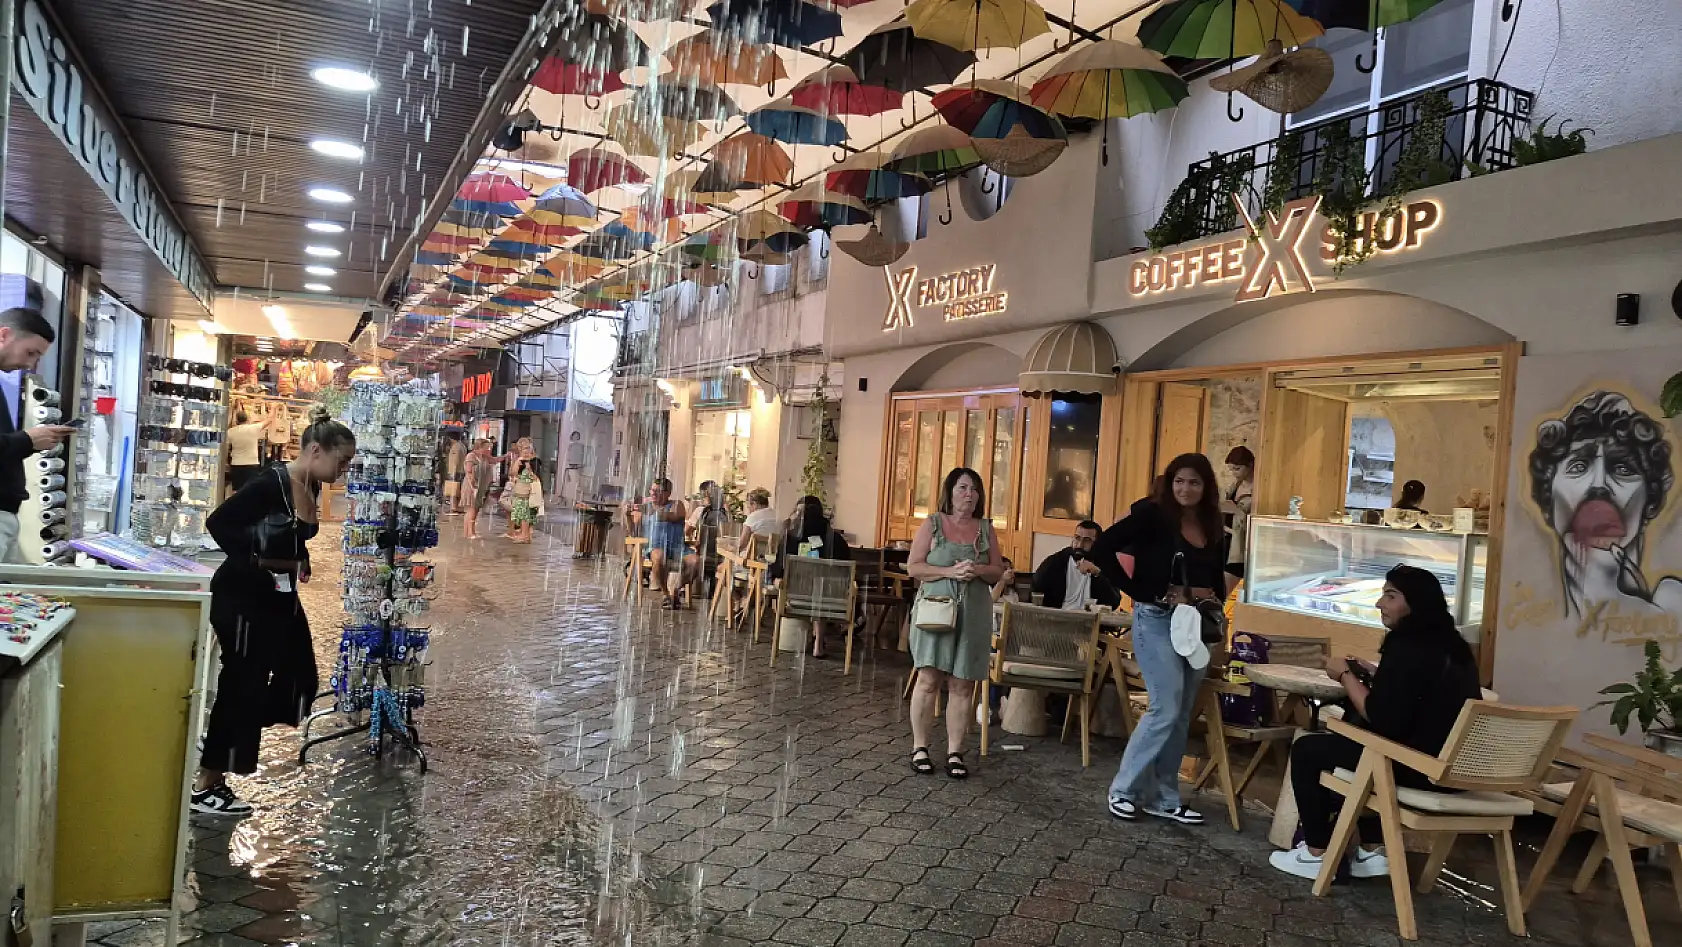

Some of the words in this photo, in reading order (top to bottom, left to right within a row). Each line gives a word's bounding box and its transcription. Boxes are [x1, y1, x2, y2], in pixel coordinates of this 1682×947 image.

[15, 0, 132, 204] Silver
[1128, 238, 1247, 296] COFFEE
[1232, 191, 1323, 303] X
[1319, 199, 1442, 264] SHOP
[881, 264, 918, 332] X
[917, 263, 996, 308] FACTORY
[943, 290, 1008, 322] PATISSERIE
